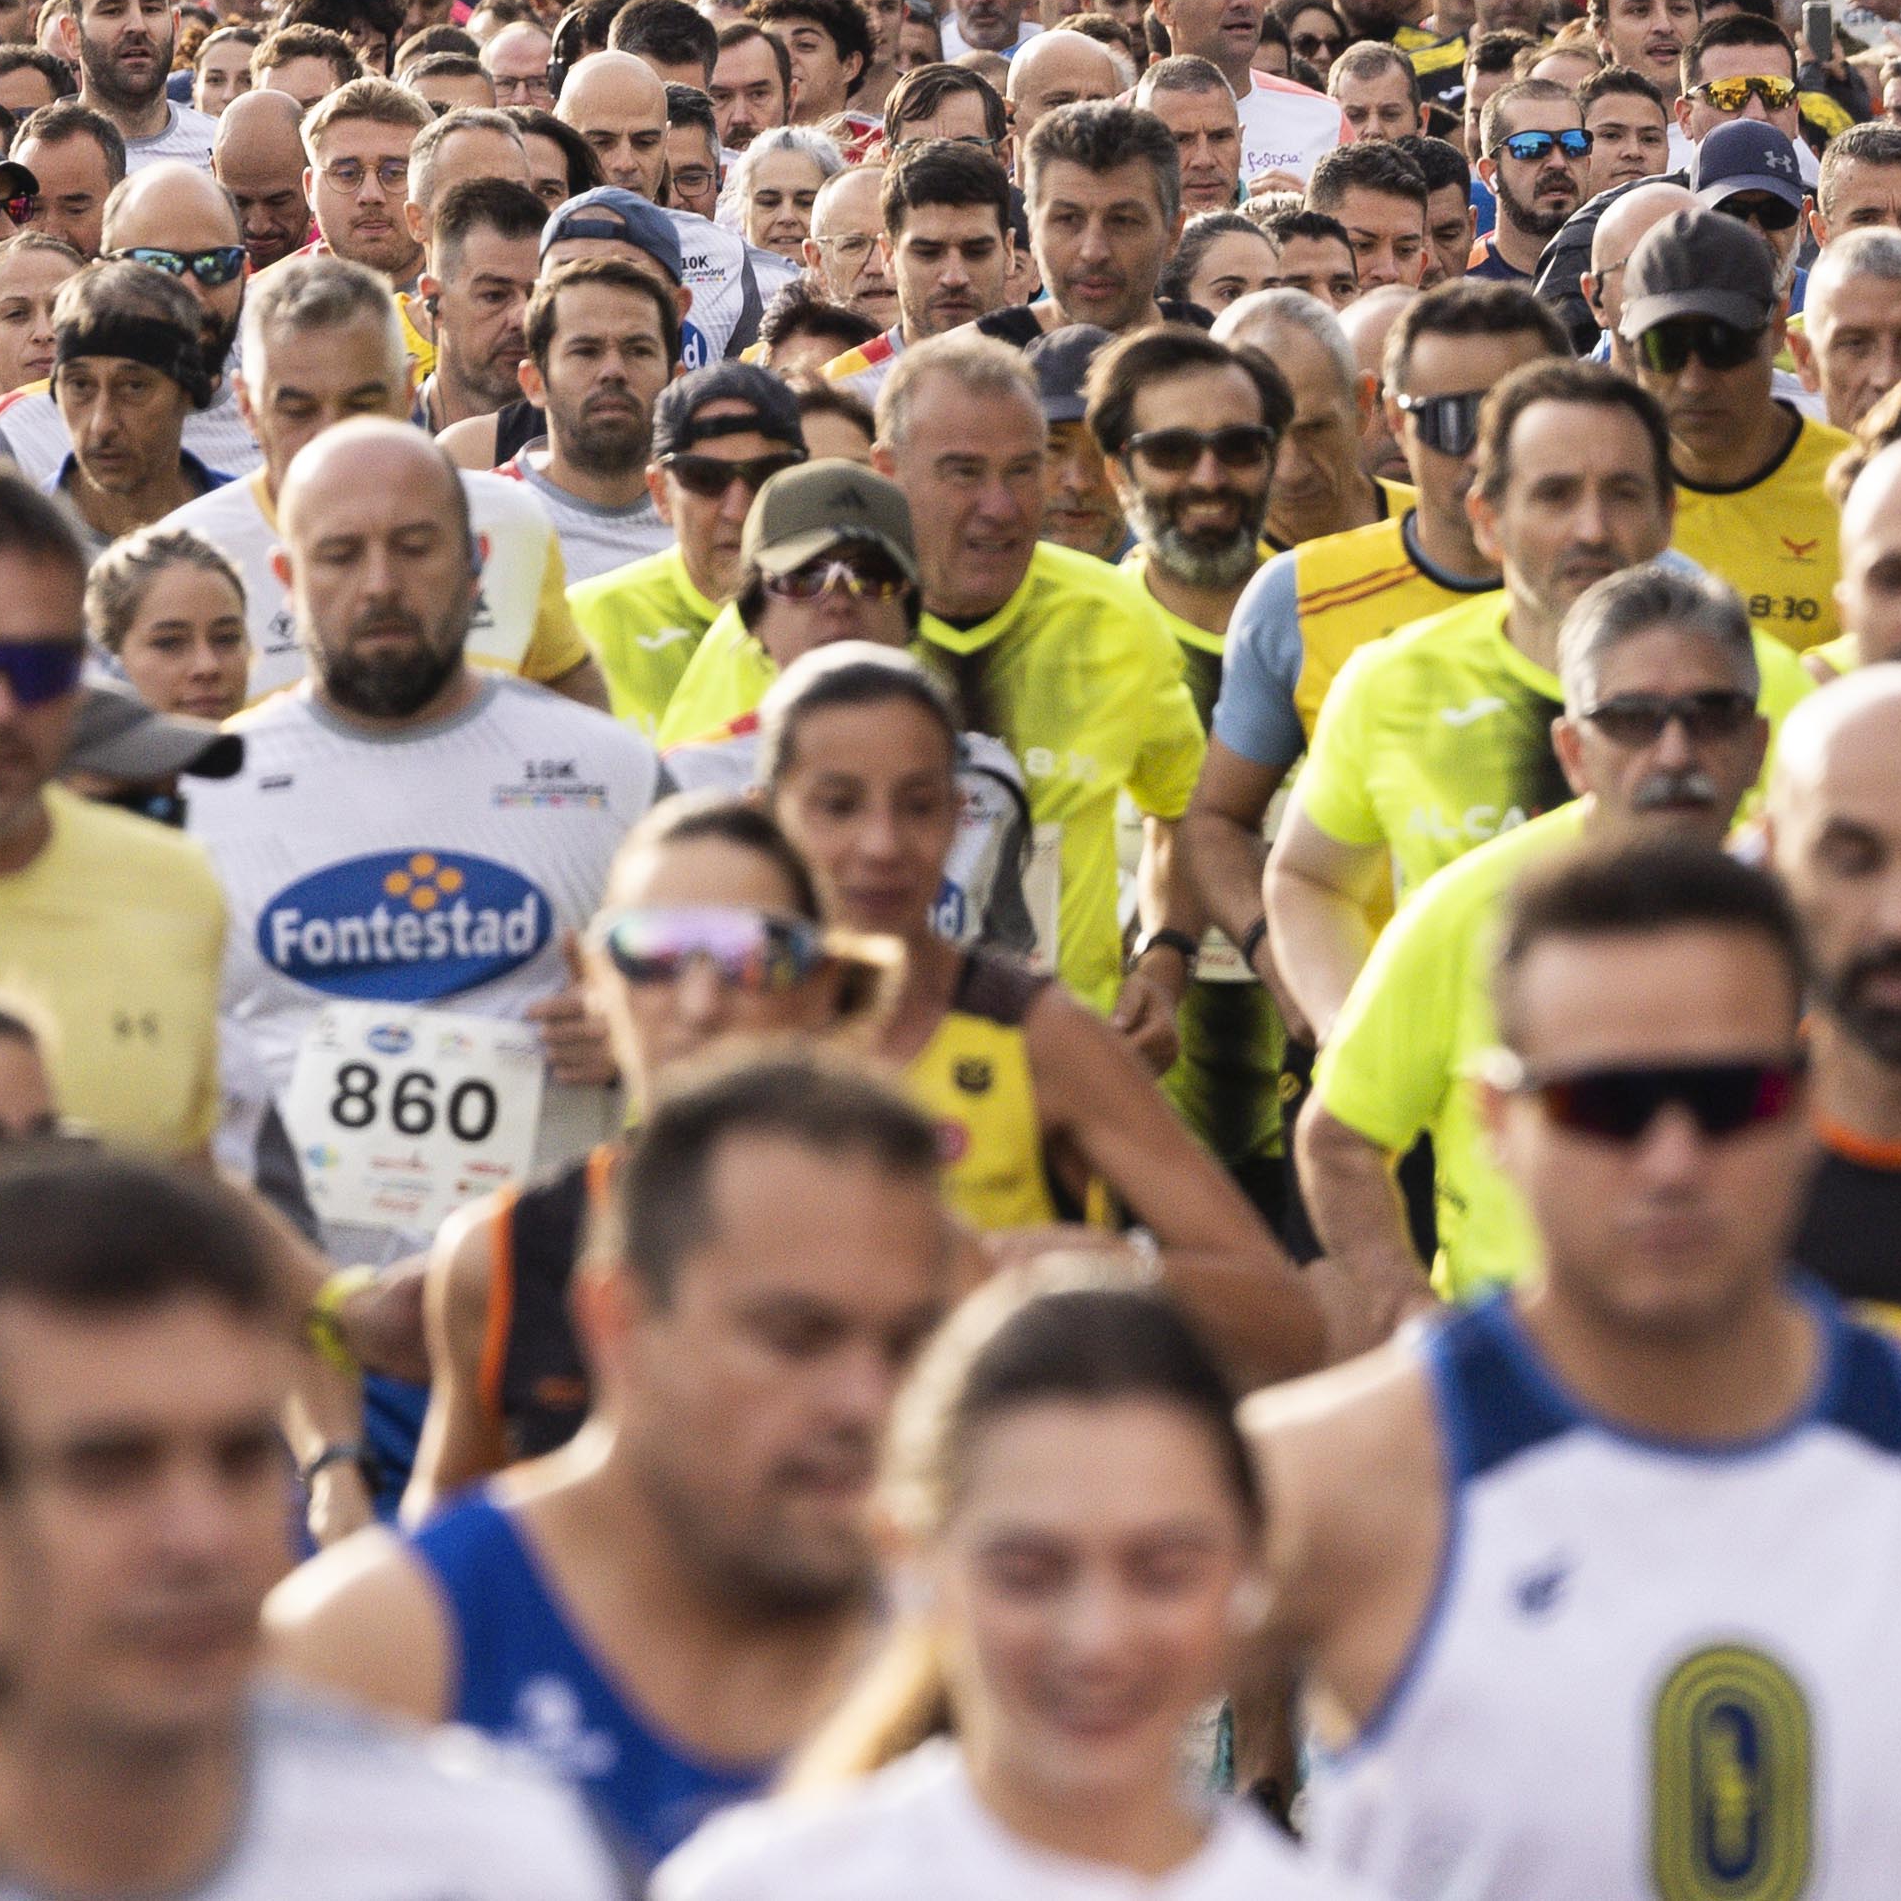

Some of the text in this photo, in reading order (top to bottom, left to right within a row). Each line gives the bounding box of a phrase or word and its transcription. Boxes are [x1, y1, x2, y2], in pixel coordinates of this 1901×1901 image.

[682, 255, 710, 270] 10K
[271, 892, 540, 966] Fontestad
[331, 1063, 498, 1143] 860
